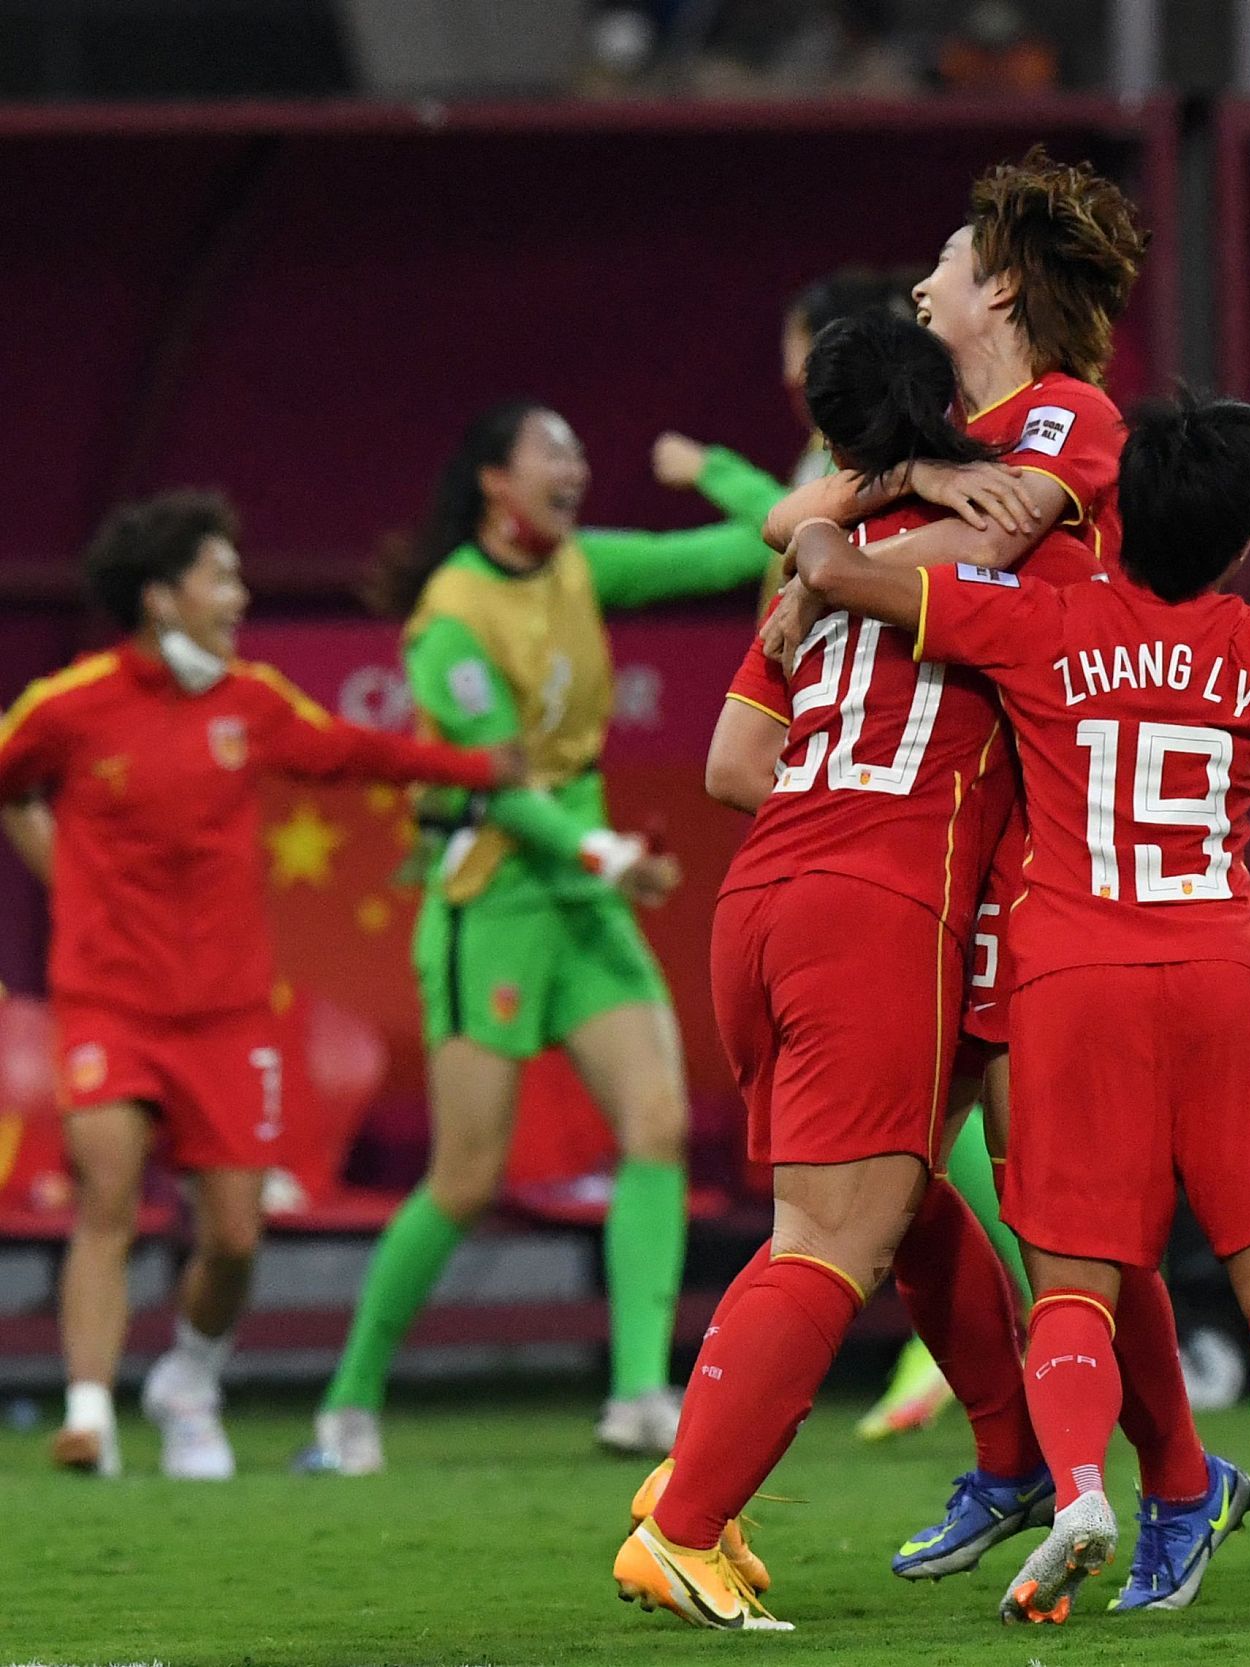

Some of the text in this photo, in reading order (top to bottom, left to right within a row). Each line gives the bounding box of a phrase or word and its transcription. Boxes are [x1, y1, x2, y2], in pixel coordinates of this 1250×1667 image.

[1041, 430, 1057, 441] ALL
[1043, 420, 1064, 433] GOAL
[1053, 640, 1193, 706] ZHANG
[772, 610, 946, 796] 20
[1076, 719, 1234, 902] 19
[1036, 1354, 1097, 1380] CFA
